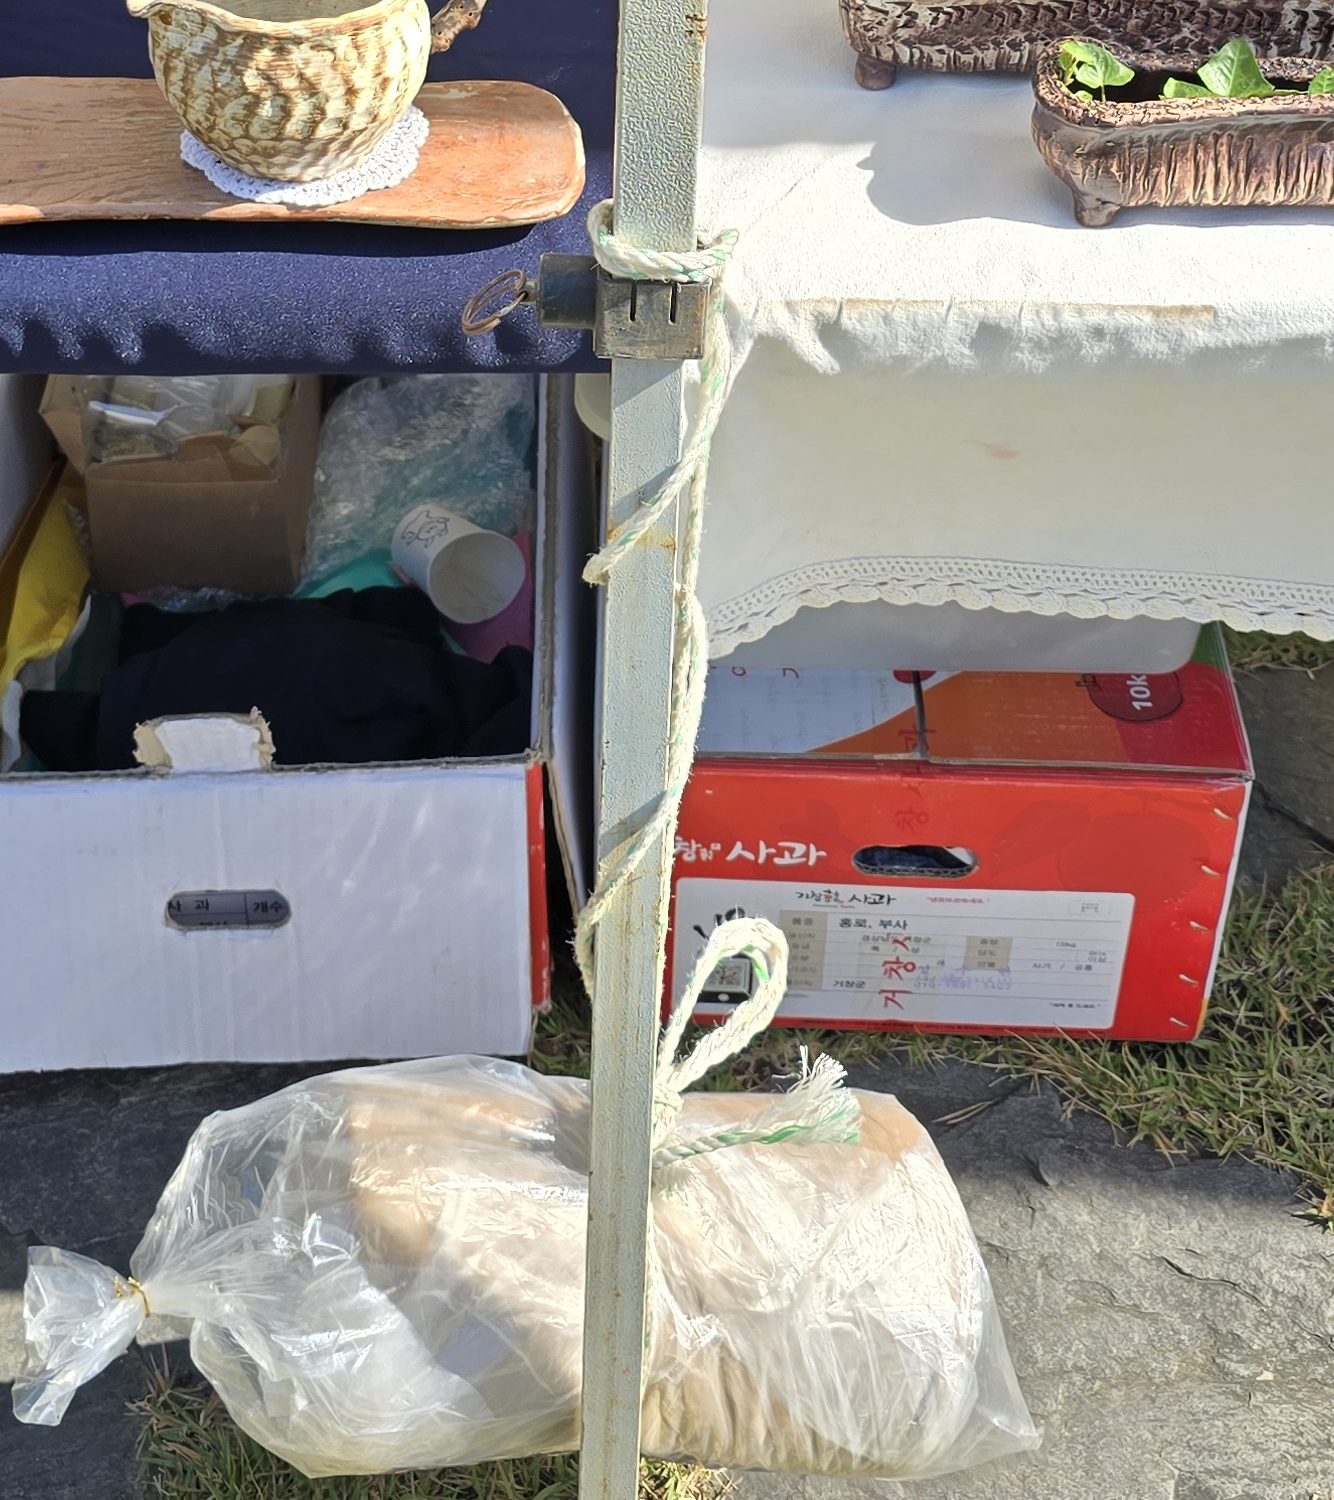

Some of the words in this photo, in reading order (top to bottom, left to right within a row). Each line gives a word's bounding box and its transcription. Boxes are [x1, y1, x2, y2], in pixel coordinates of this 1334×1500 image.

[1126, 673, 1152, 710] 10k
[726, 840, 827, 867] 사과
[847, 893, 897, 905] 사과
[253, 901, 284, 913] 개수
[878, 919, 908, 930] 부사
